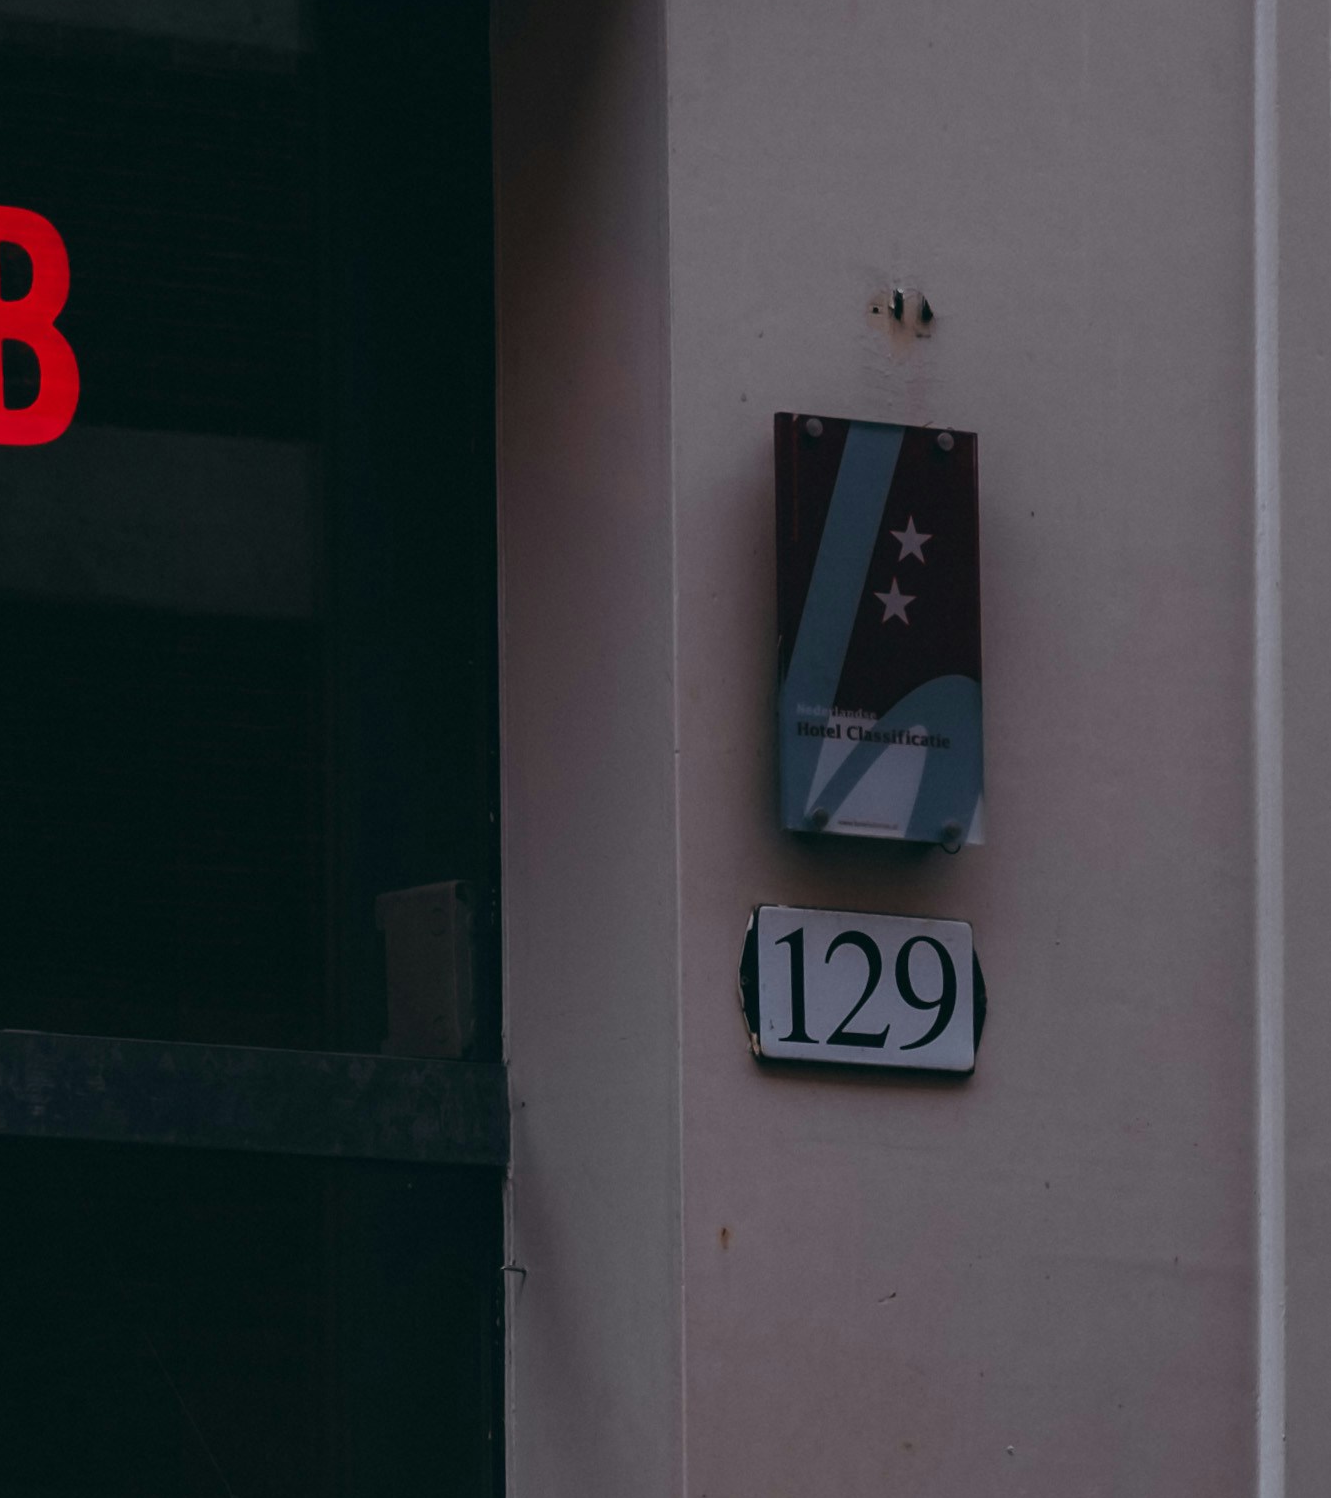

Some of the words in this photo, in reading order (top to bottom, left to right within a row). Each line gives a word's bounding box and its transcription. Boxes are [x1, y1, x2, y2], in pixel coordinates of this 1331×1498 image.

[797, 721, 841, 739] Hotel
[847, 726, 951, 749] Classificatie
[774, 926, 958, 1051] 129
